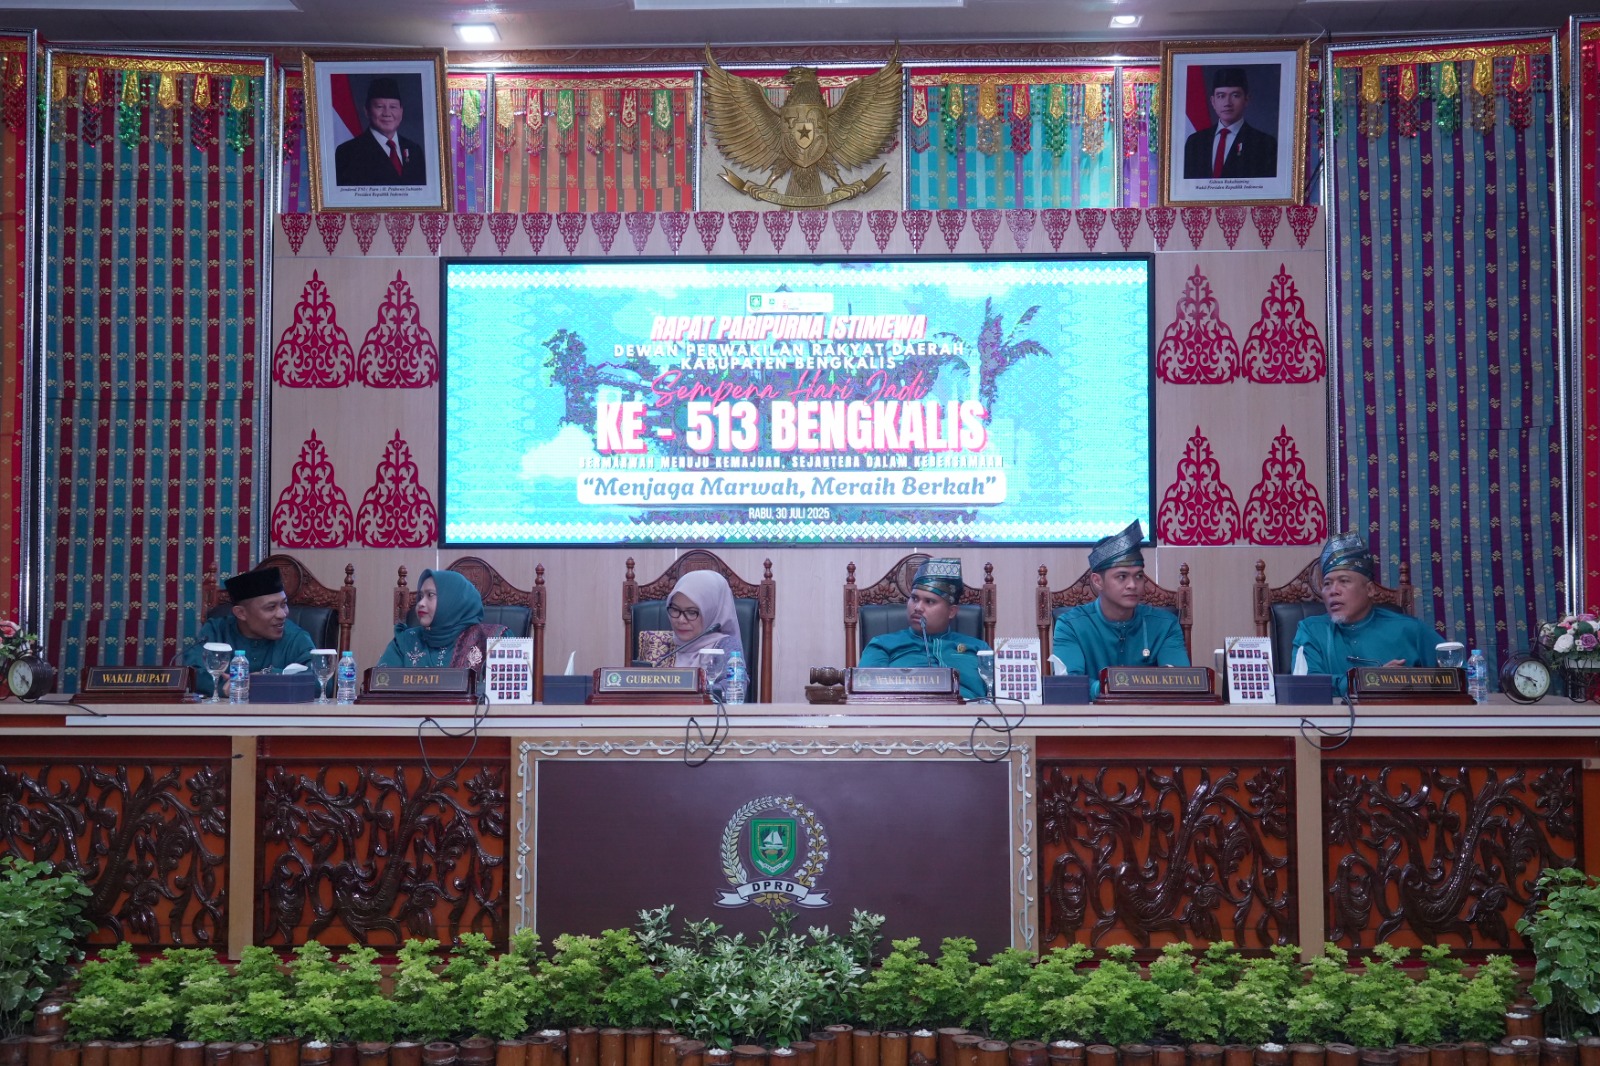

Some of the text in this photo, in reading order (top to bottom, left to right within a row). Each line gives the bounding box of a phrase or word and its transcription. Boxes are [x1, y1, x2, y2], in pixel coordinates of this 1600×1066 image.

[651, 314, 927, 341] RAPAT PARIPURNA ISTIMEWA
[614, 343, 963, 357] DEWAN PERWAKILAN RAKYAT DAERAH
[680, 356, 896, 370] KABUPATEN BENGKALIS
[651, 370, 928, 407] Sempena Hari Jadi
[597, 400, 988, 453] KE - 513 BENGKALIS
[661, 456, 709, 468] MENUJU
[715, 456, 786, 469] KEMAJUAN,
[867, 456, 908, 468] DALAM
[700, 477, 806, 499] Marwah,
[811, 476, 896, 495] Meraih
[776, 507, 787, 519] 30
[789, 507, 806, 519] JULI
[807, 507, 830, 519] 2025
[102, 673, 171, 683] WAKIL BUPATI
[403, 674, 439, 684] BUPATI
[626, 675, 681, 684] GUBERNUR
[875, 675, 904, 685] WAKIL
[905, 675, 935, 685] KETUA
[1131, 675, 1200, 685] WAKIL KETUA II
[1380, 675, 1452, 684] WAKIL KETUA III
[752, 881, 794, 892] DPRD
